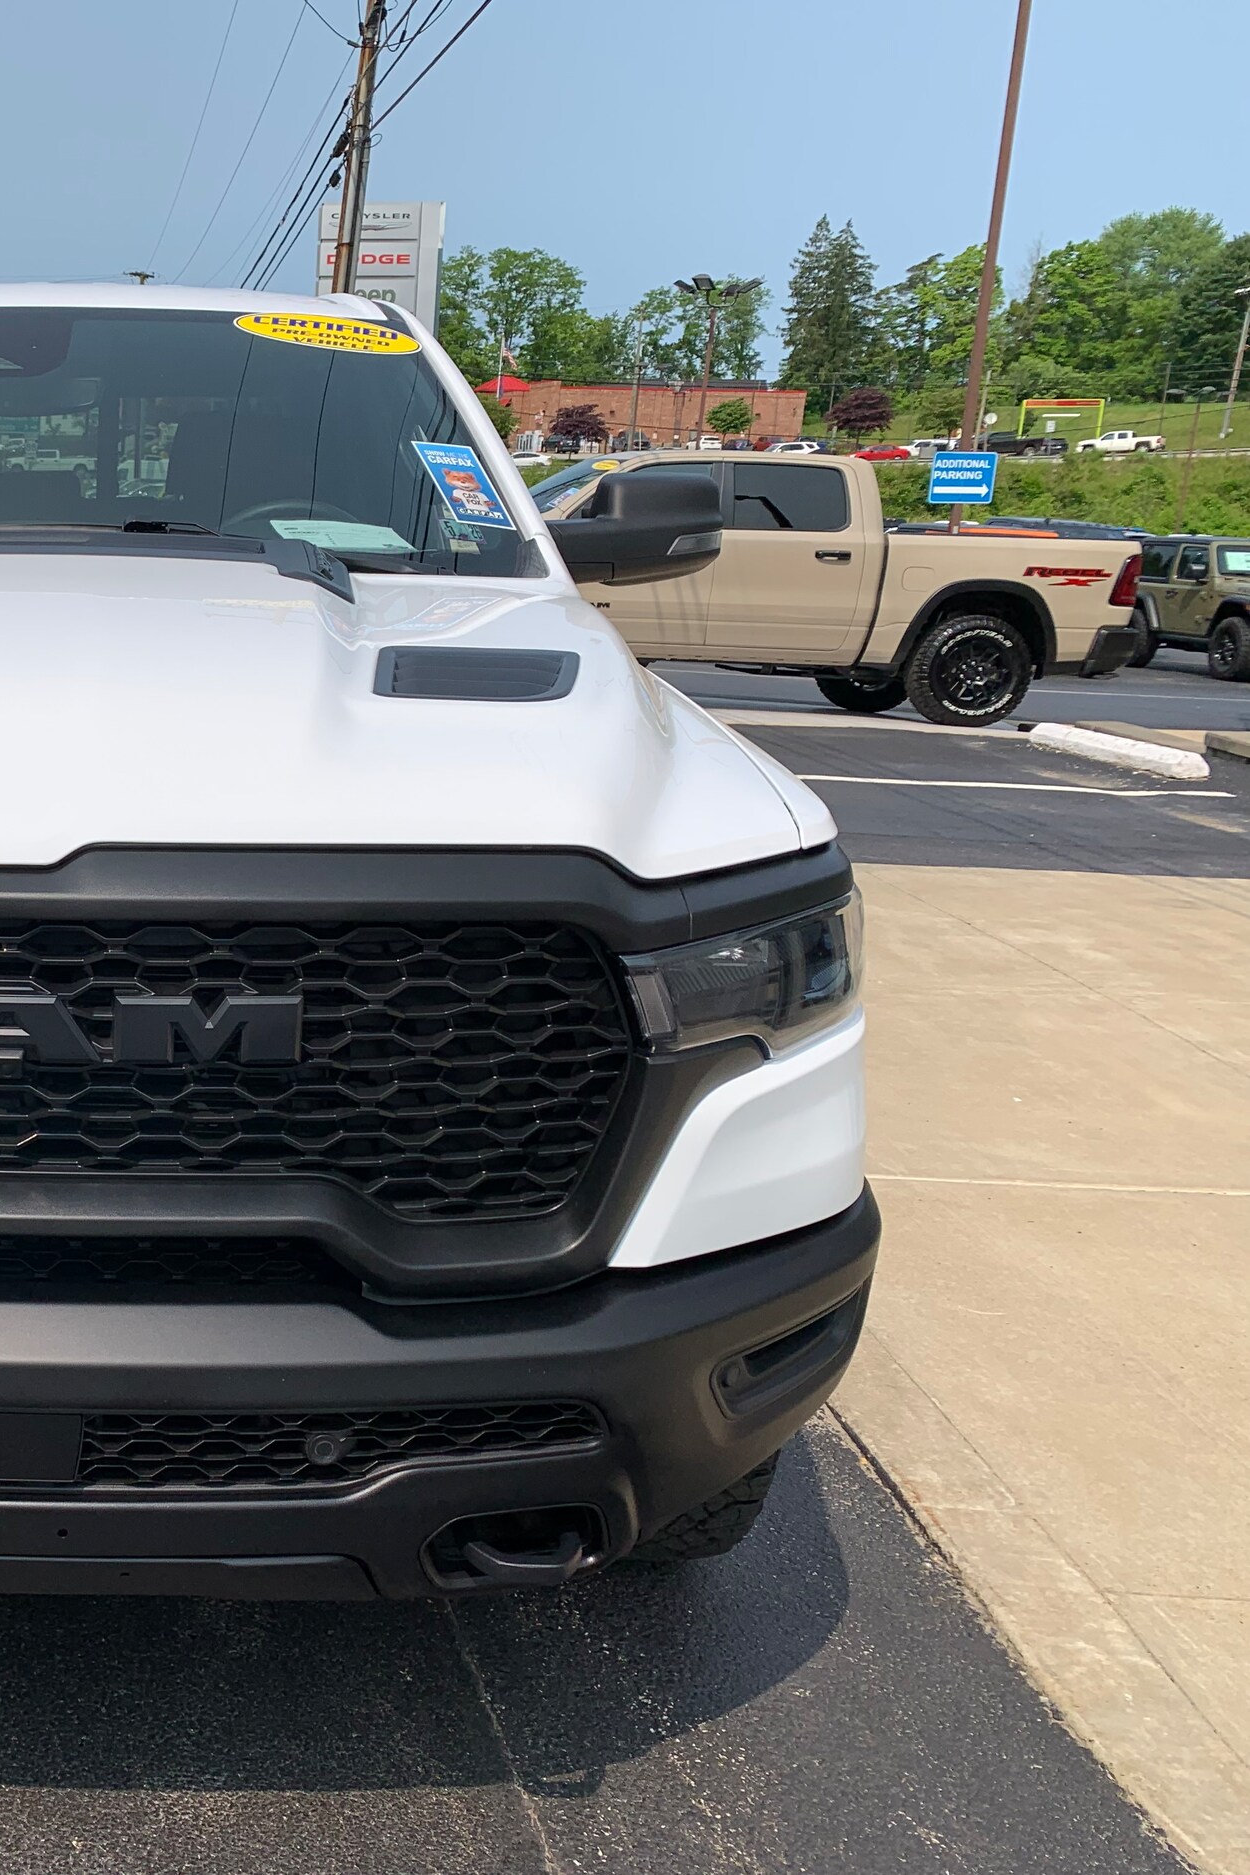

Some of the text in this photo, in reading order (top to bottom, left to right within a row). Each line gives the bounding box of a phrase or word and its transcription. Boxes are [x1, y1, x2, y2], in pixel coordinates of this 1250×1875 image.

[331, 212, 411, 220] CYSLER
[326, 254, 411, 265] DDGE
[353, 289, 397, 303] eep
[253, 316, 398, 340] CERTIFIED
[272, 328, 390, 346] PRE-OWNED
[293, 337, 374, 351] VEHICLE
[427, 455, 475, 467] CARFAX
[935, 459, 991, 469] ADDITIONAL
[933, 471, 983, 479] PARKING
[462, 492, 480, 500] CAR
[457, 507, 503, 519] CARFAX
[1023, 566, 1114, 578] REBEL
[941, 629, 1013, 655] GOODYEAR
